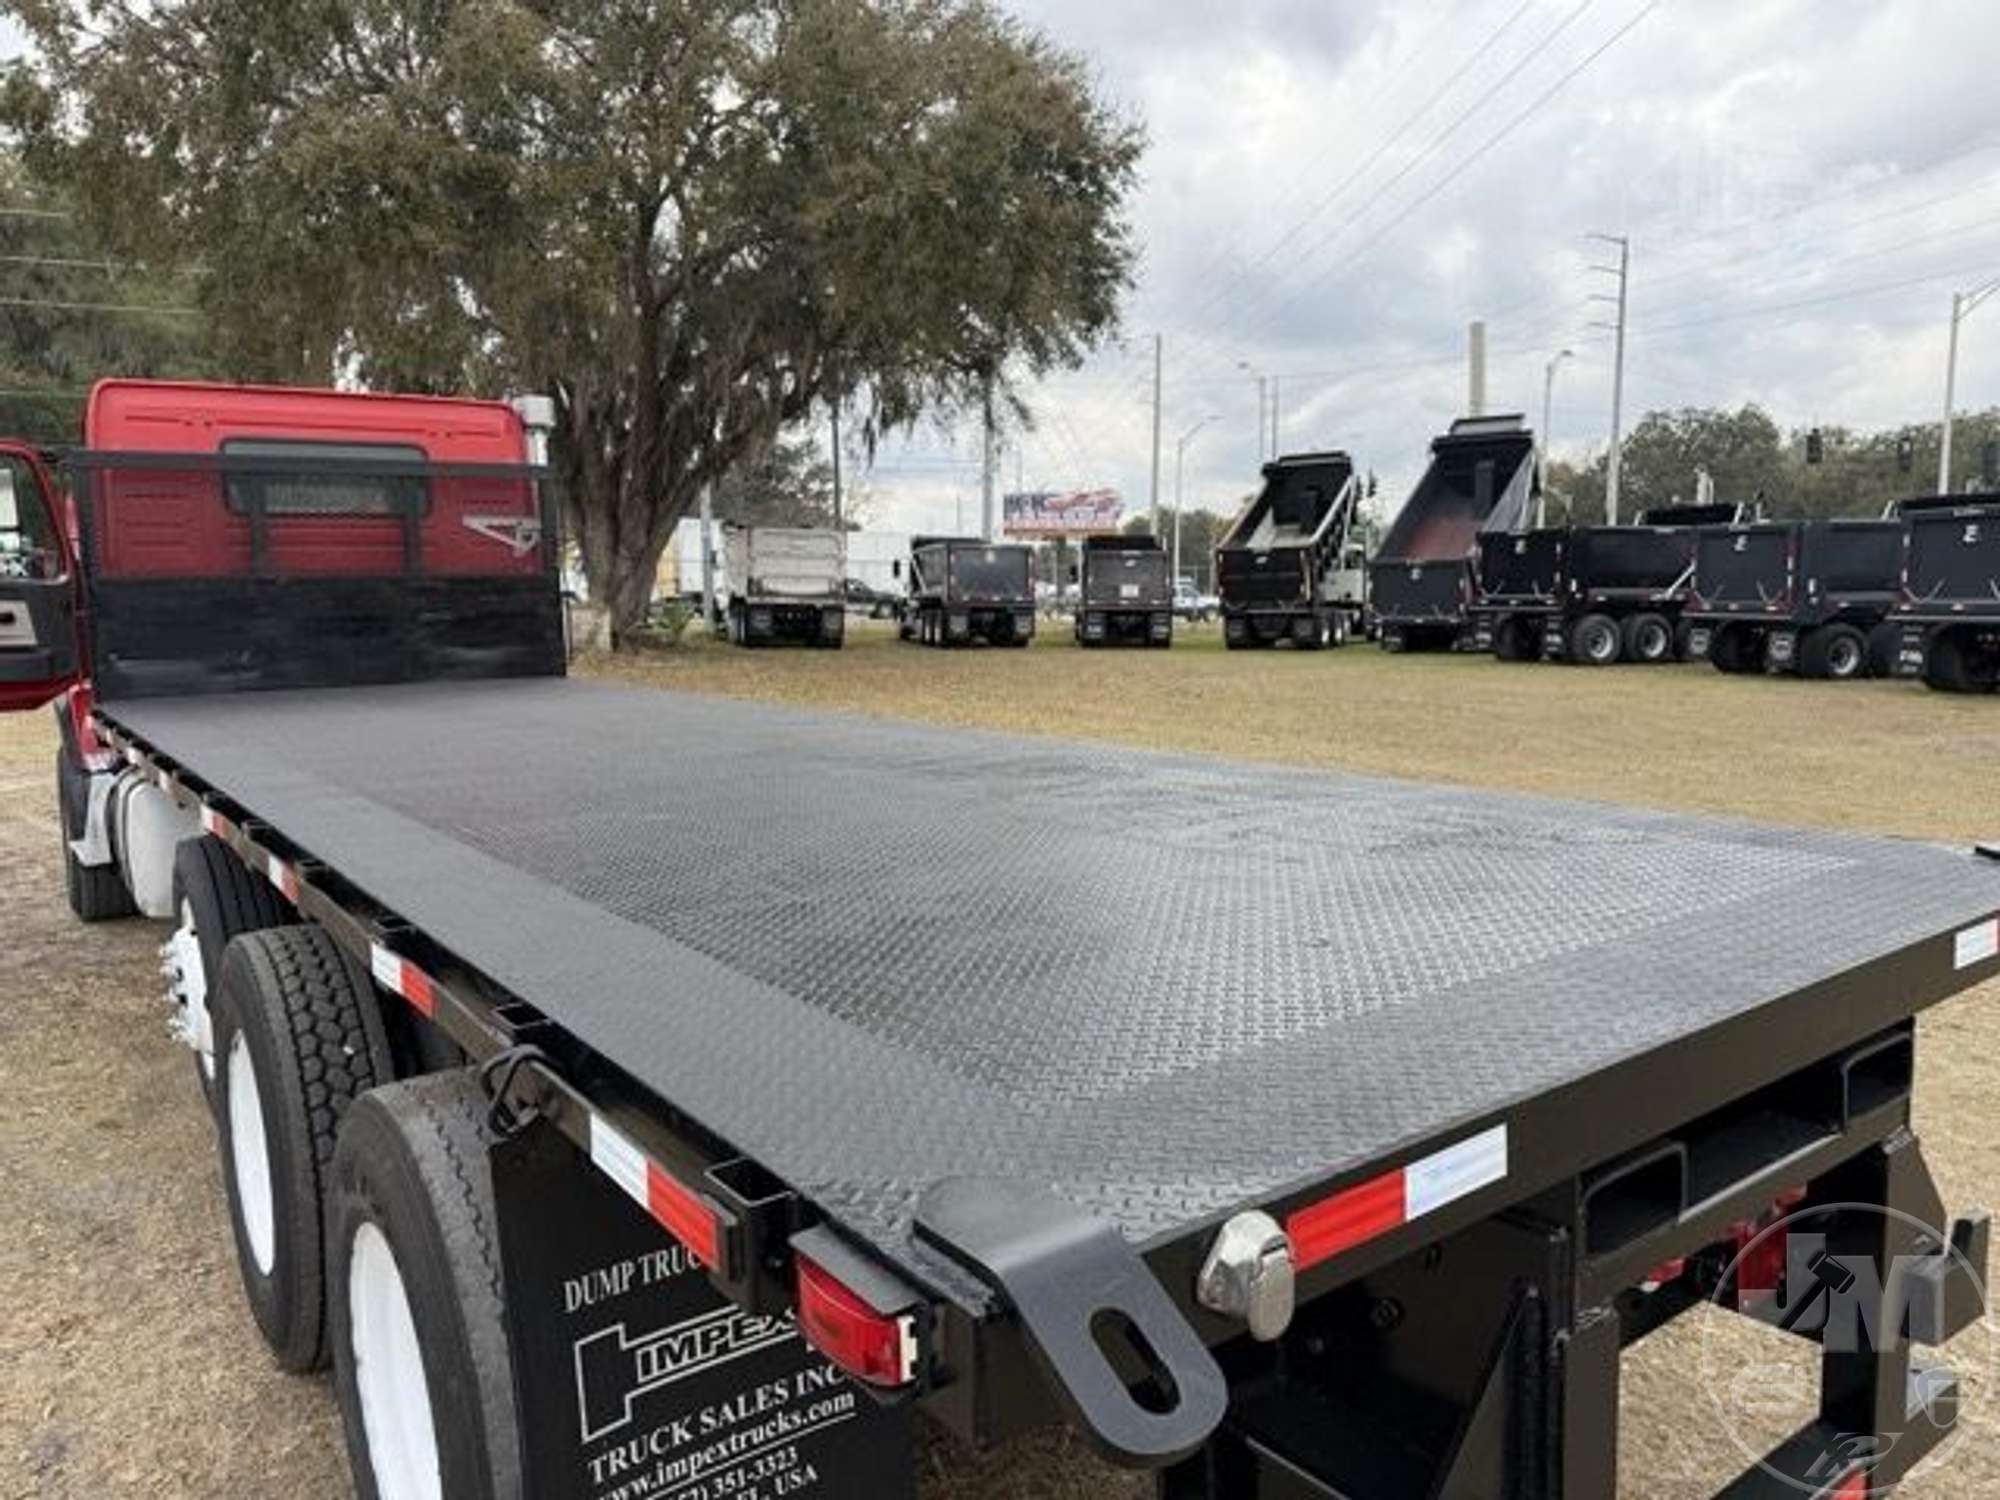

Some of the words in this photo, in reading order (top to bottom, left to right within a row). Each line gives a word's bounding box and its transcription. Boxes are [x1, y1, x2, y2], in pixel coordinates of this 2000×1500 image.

[563, 1258, 637, 1314] DUMP
[587, 1414, 693, 1484] TRUCK
[699, 1378, 790, 1434] SALES
[599, 1391, 857, 1500] ww.impextrucks.com
[712, 1445, 798, 1499] 351-3323
[774, 1463, 818, 1496] USA
